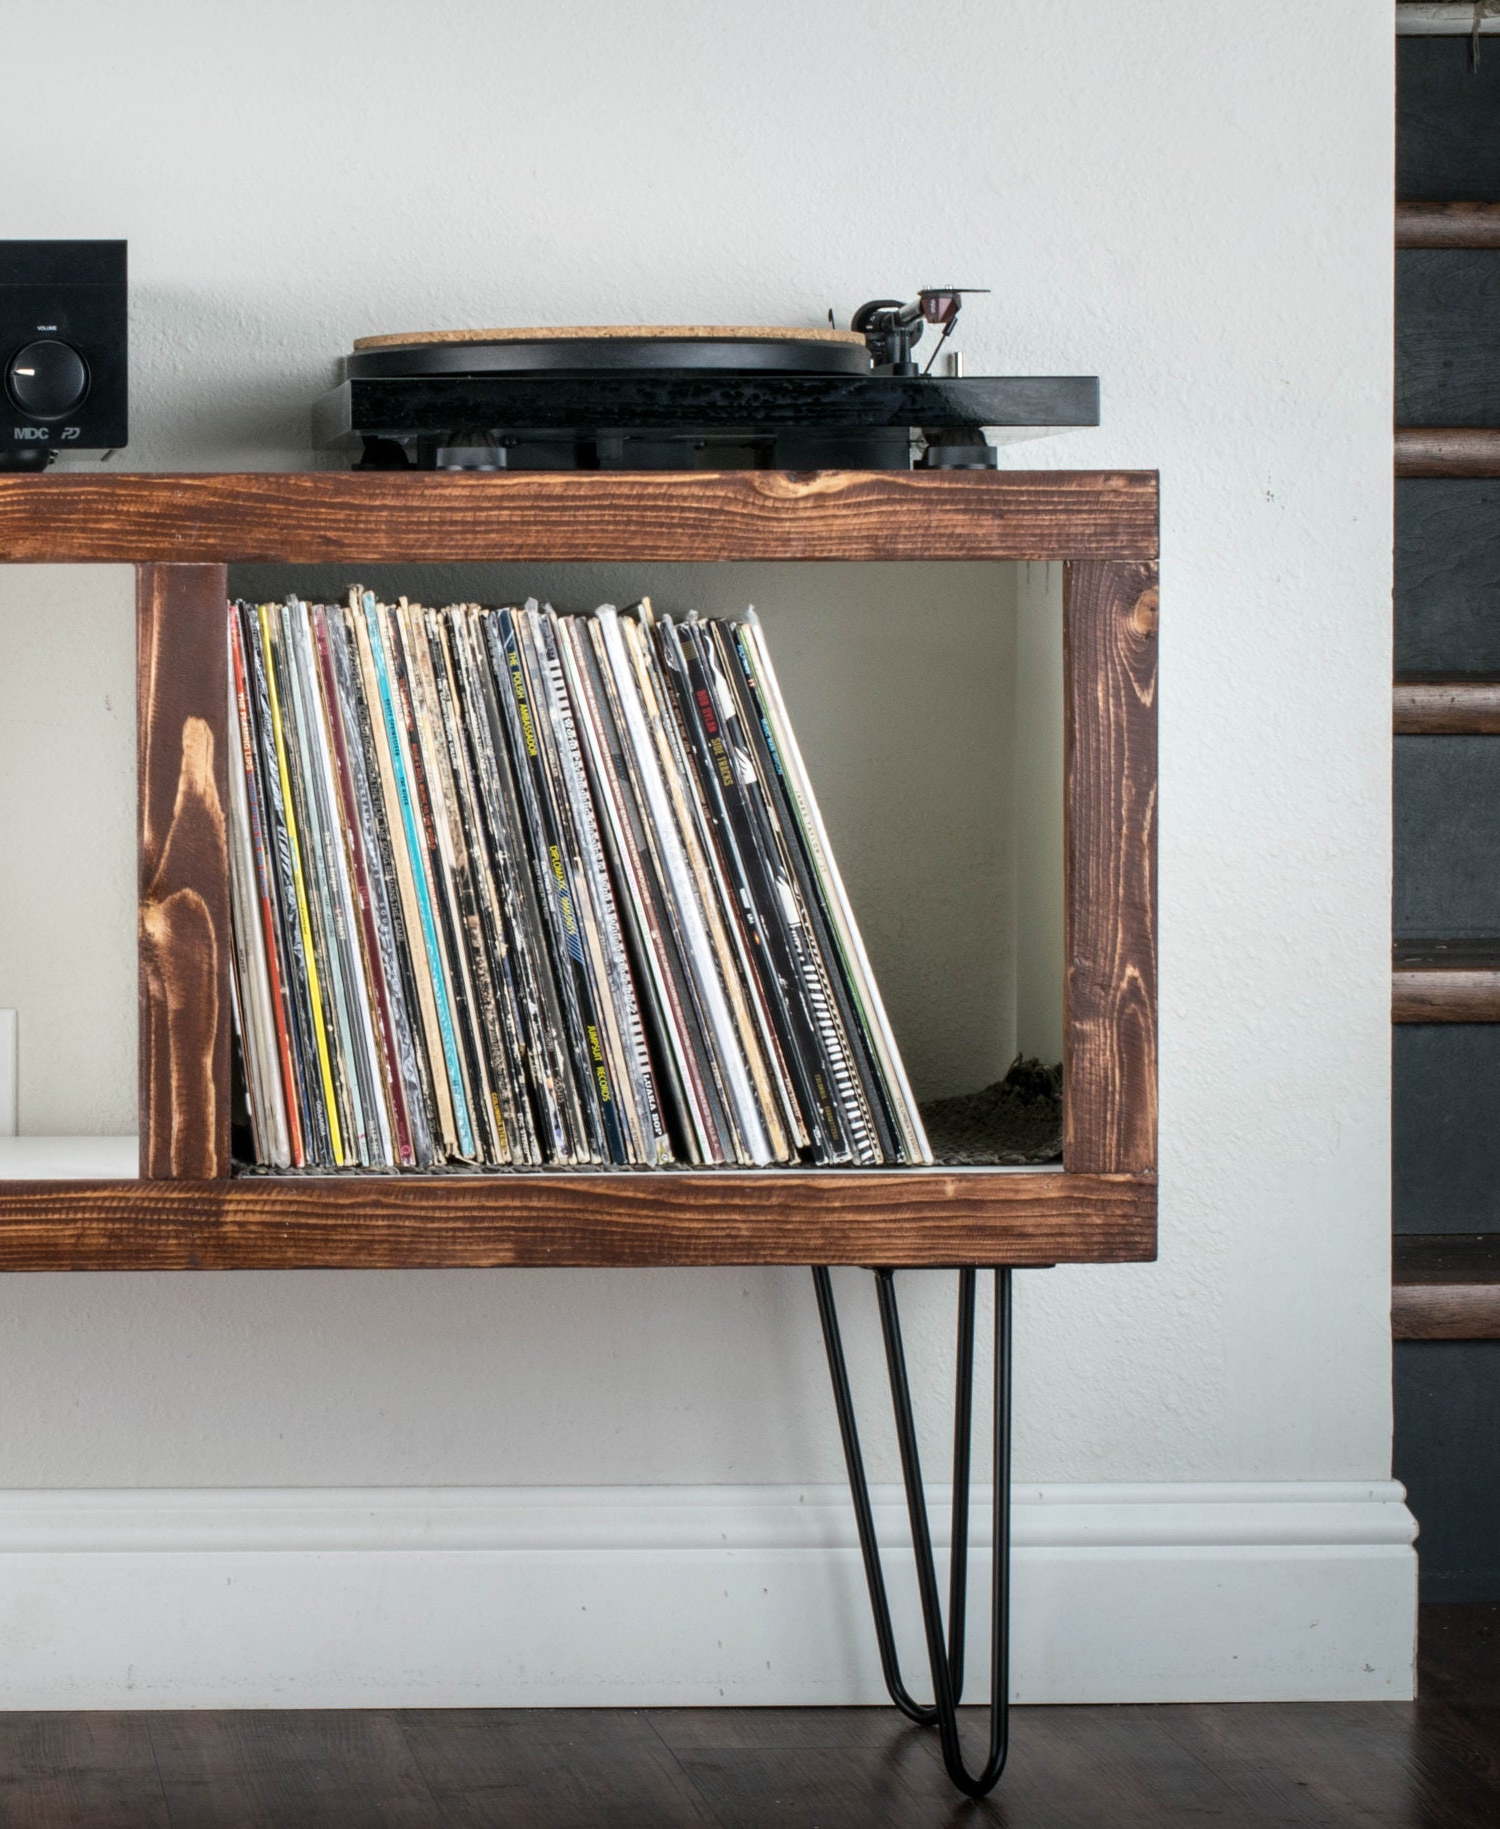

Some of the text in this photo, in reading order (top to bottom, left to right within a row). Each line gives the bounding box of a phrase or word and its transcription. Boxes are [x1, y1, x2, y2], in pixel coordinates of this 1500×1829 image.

[14, 427, 49, 440] MDC
[569, 626, 579, 642] CPN
[236, 692, 245, 705] THE
[532, 678, 543, 704] MICHAEL
[508, 651, 537, 756] THE POLISH AMBASSADOR
[695, 689, 719, 732] BOB DYLAN
[239, 711, 250, 749] FLAMING
[438, 692, 452, 740] CLASH/LONDON
[447, 743, 457, 768] CALLING
[563, 717, 578, 748] World
[244, 751, 253, 770] LIPS
[410, 743, 420, 759] ROCK
[709, 737, 735, 786] SIDE TRACKS
[583, 680, 652, 904] THE ALLMAN BROTHERS BAND/ENLIGHTENED ROGUES
[373, 800, 383, 818] FILM
[422, 805, 429, 813] TO
[423, 815, 431, 825] THE
[794, 790, 808, 816] JAMES
[805, 822, 820, 852] TAYLOR
[323, 832, 331, 844] The
[377, 824, 387, 839] THE
[426, 827, 436, 849] WORLD
[325, 845, 334, 866] White
[380, 840, 391, 863] SONG
[328, 867, 338, 891] Stripes
[549, 845, 566, 890] DIPLOMATIC
[390, 902, 400, 916] THE
[393, 918, 404, 940] SAME
[658, 952, 679, 1004] CAPRICORN
[673, 1006, 691, 1046] RECORDS
[693, 1079, 711, 1115] PRINTED
[704, 1117, 714, 1126] IN
[586, 1025, 610, 1101] JUMPSUIT RECORDS
[813, 1074, 827, 1099] COLUMBIA
[490, 1092, 503, 1126] COLUMBIA
[642, 1074, 662, 1135] LUAKA BOP
[895, 1097, 911, 1128] COLUMBIA
[315, 1100, 326, 1136] COLUMBIA
[519, 1129, 528, 1153] STEREO
